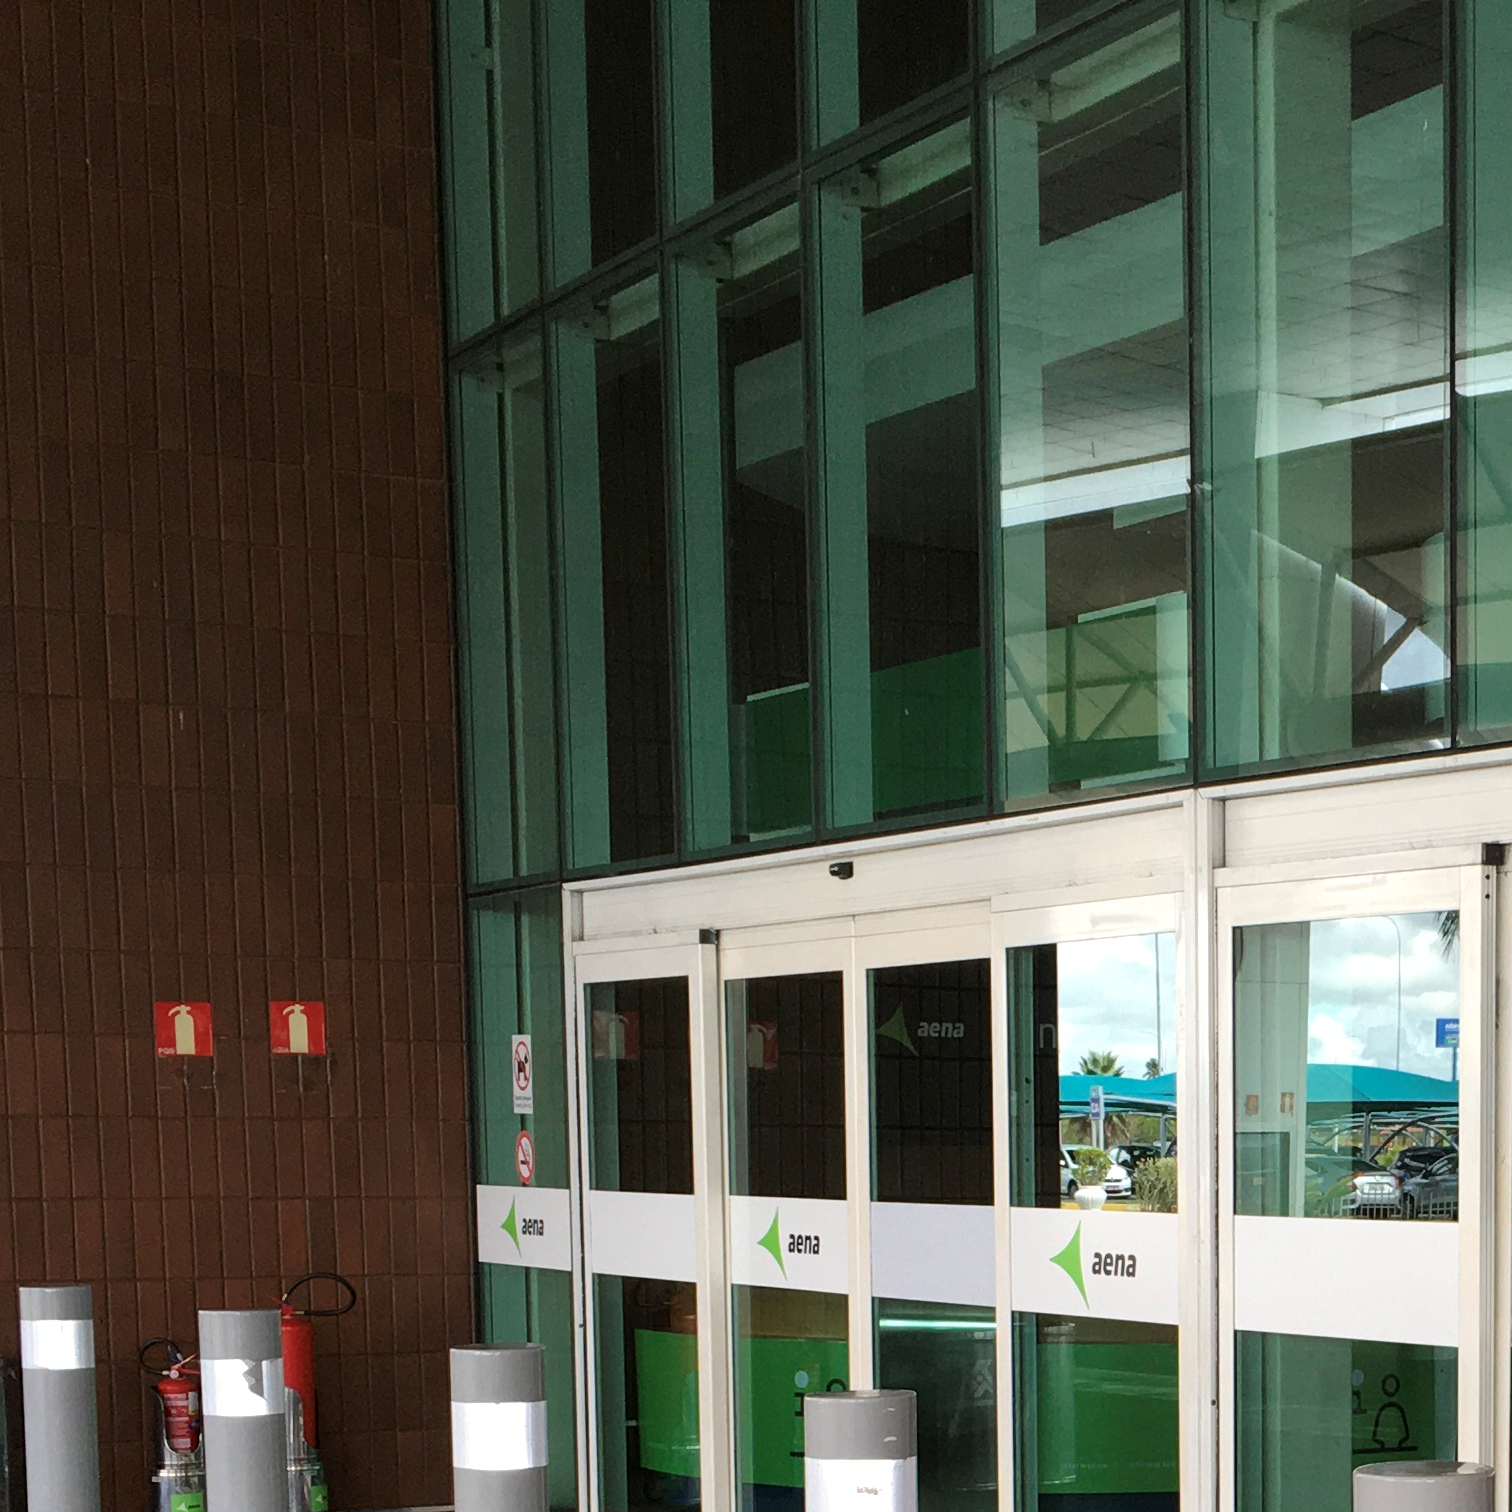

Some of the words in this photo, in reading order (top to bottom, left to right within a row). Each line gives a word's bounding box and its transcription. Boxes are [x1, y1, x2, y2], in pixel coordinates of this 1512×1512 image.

[917, 1021, 965, 1038] aena
[521, 1217, 544, 1236] aena
[788, 1233, 820, 1255] aena
[1092, 1252, 1137, 1278] aena
